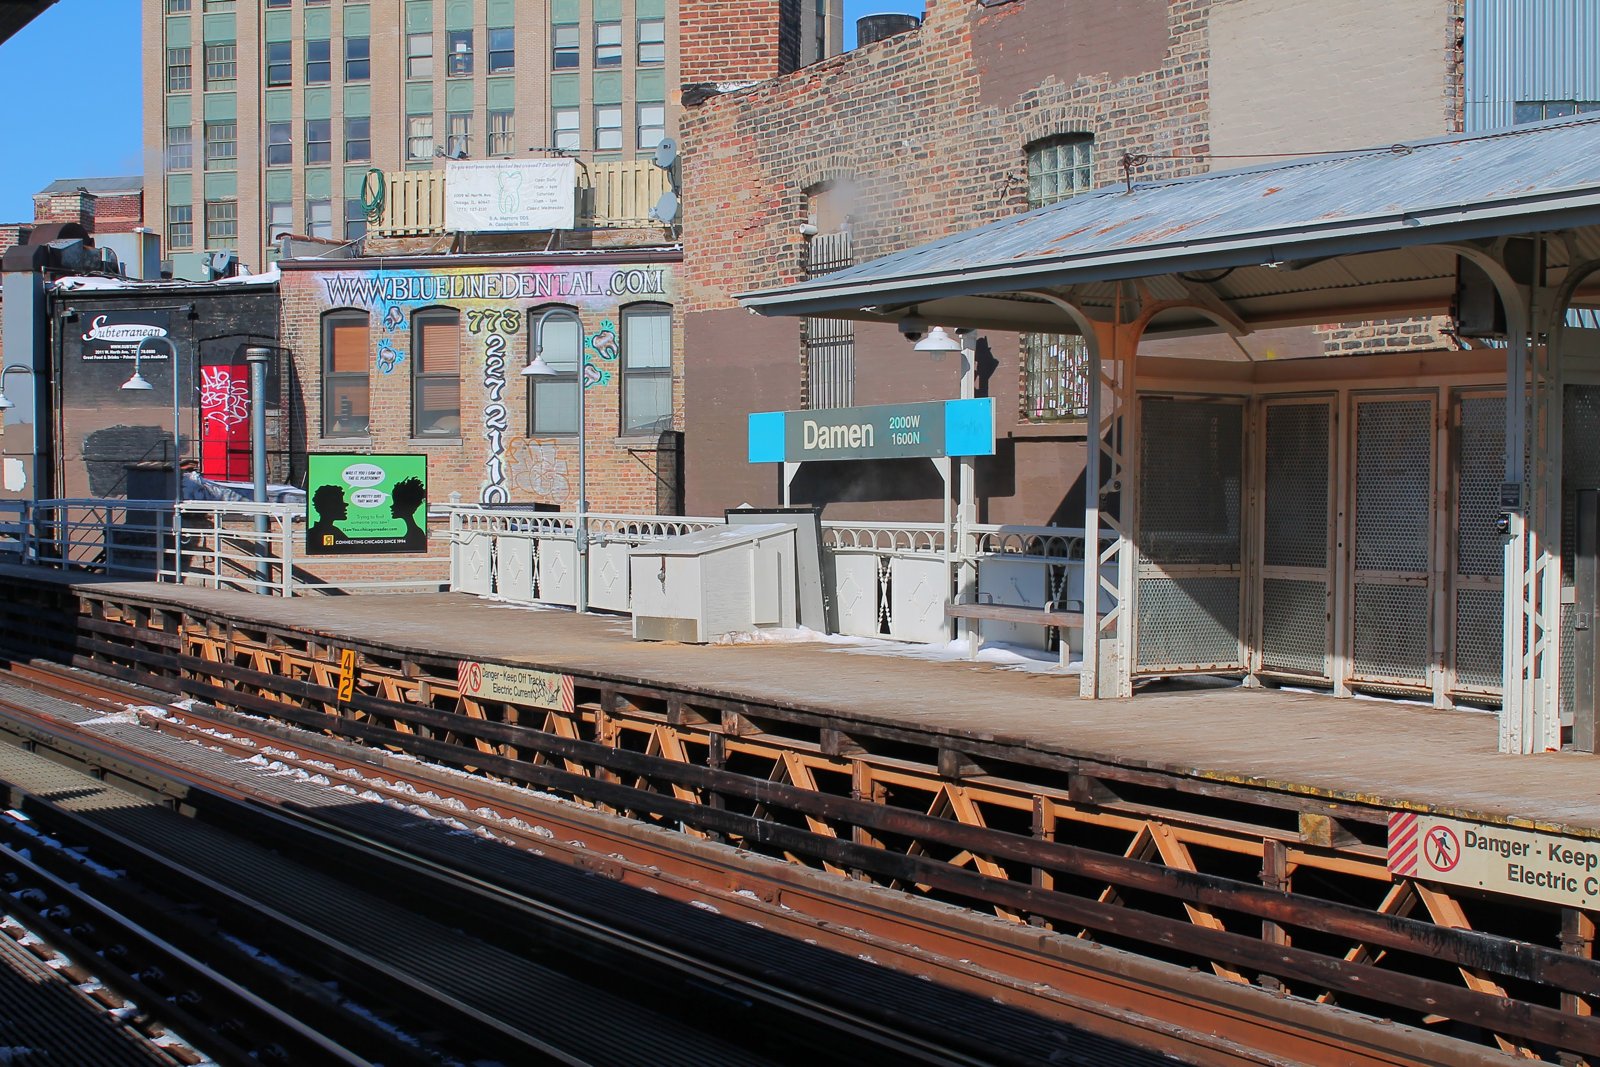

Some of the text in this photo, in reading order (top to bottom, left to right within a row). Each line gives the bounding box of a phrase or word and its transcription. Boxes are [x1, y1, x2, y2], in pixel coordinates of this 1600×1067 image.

[82, 315, 160, 341] Subterranean
[467, 309, 521, 335] 773
[803, 420, 874, 450] Damen
[889, 415, 921, 429] 2000W
[891, 431, 920, 445] 1600N
[482, 668, 499, 681] Danger
[503, 671, 517, 683] Keep
[518, 673, 527, 682] Off
[493, 683, 512, 695] Electric
[1464, 830, 1530, 858] Danger
[1548, 843, 1598, 872] Keep
[1507, 863, 1600, 896] Electric C
